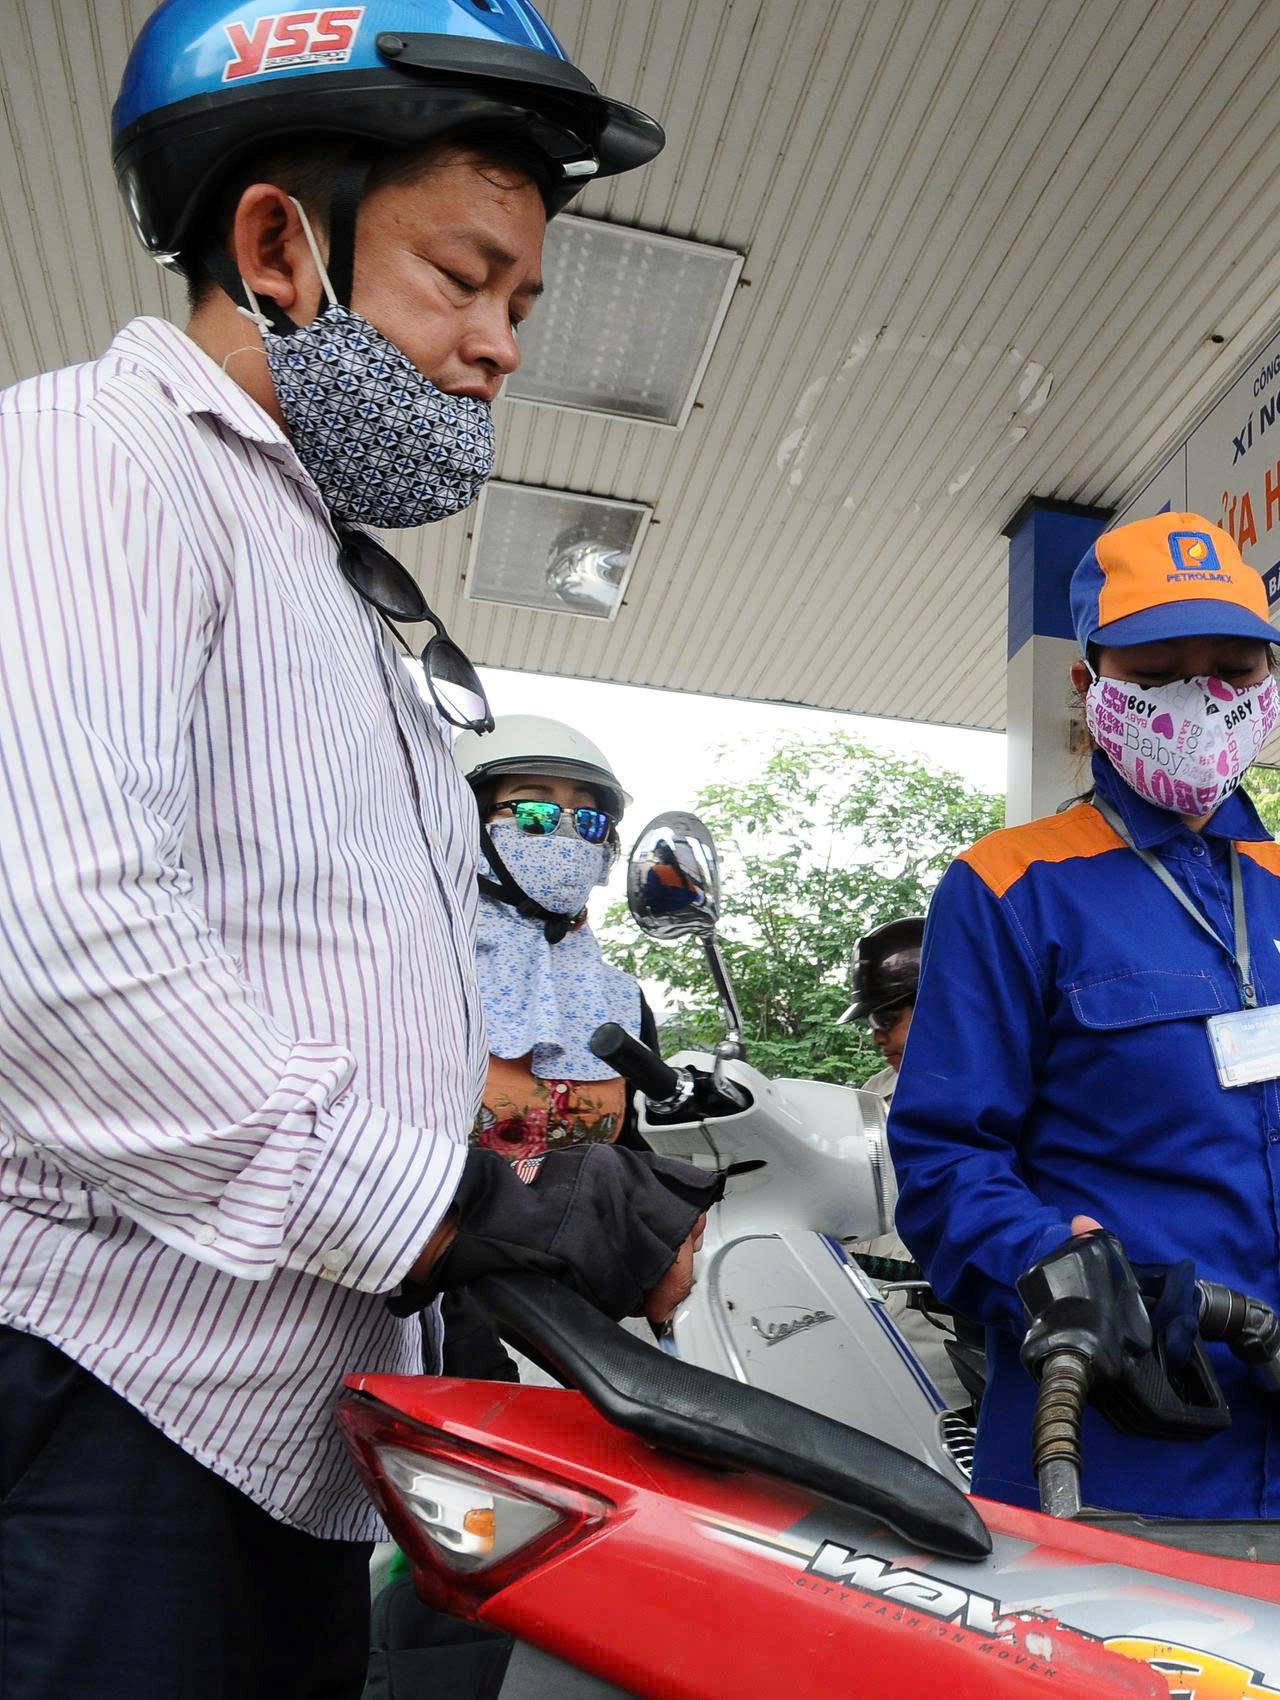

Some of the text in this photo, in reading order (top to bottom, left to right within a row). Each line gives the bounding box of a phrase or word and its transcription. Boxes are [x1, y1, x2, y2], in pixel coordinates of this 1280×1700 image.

[226, 10, 362, 79] YSS
[1253, 354, 1280, 397] CÔNG
[1232, 411, 1253, 466] XÍ
[1217, 491, 1257, 556] ỬA
[1127, 695, 1157, 718] BOY
[1224, 699, 1253, 730] BABY
[1124, 721, 1185, 776] Baby
[796, 1577, 849, 1601] CITY
[862, 1600, 967, 1644] FASHON
